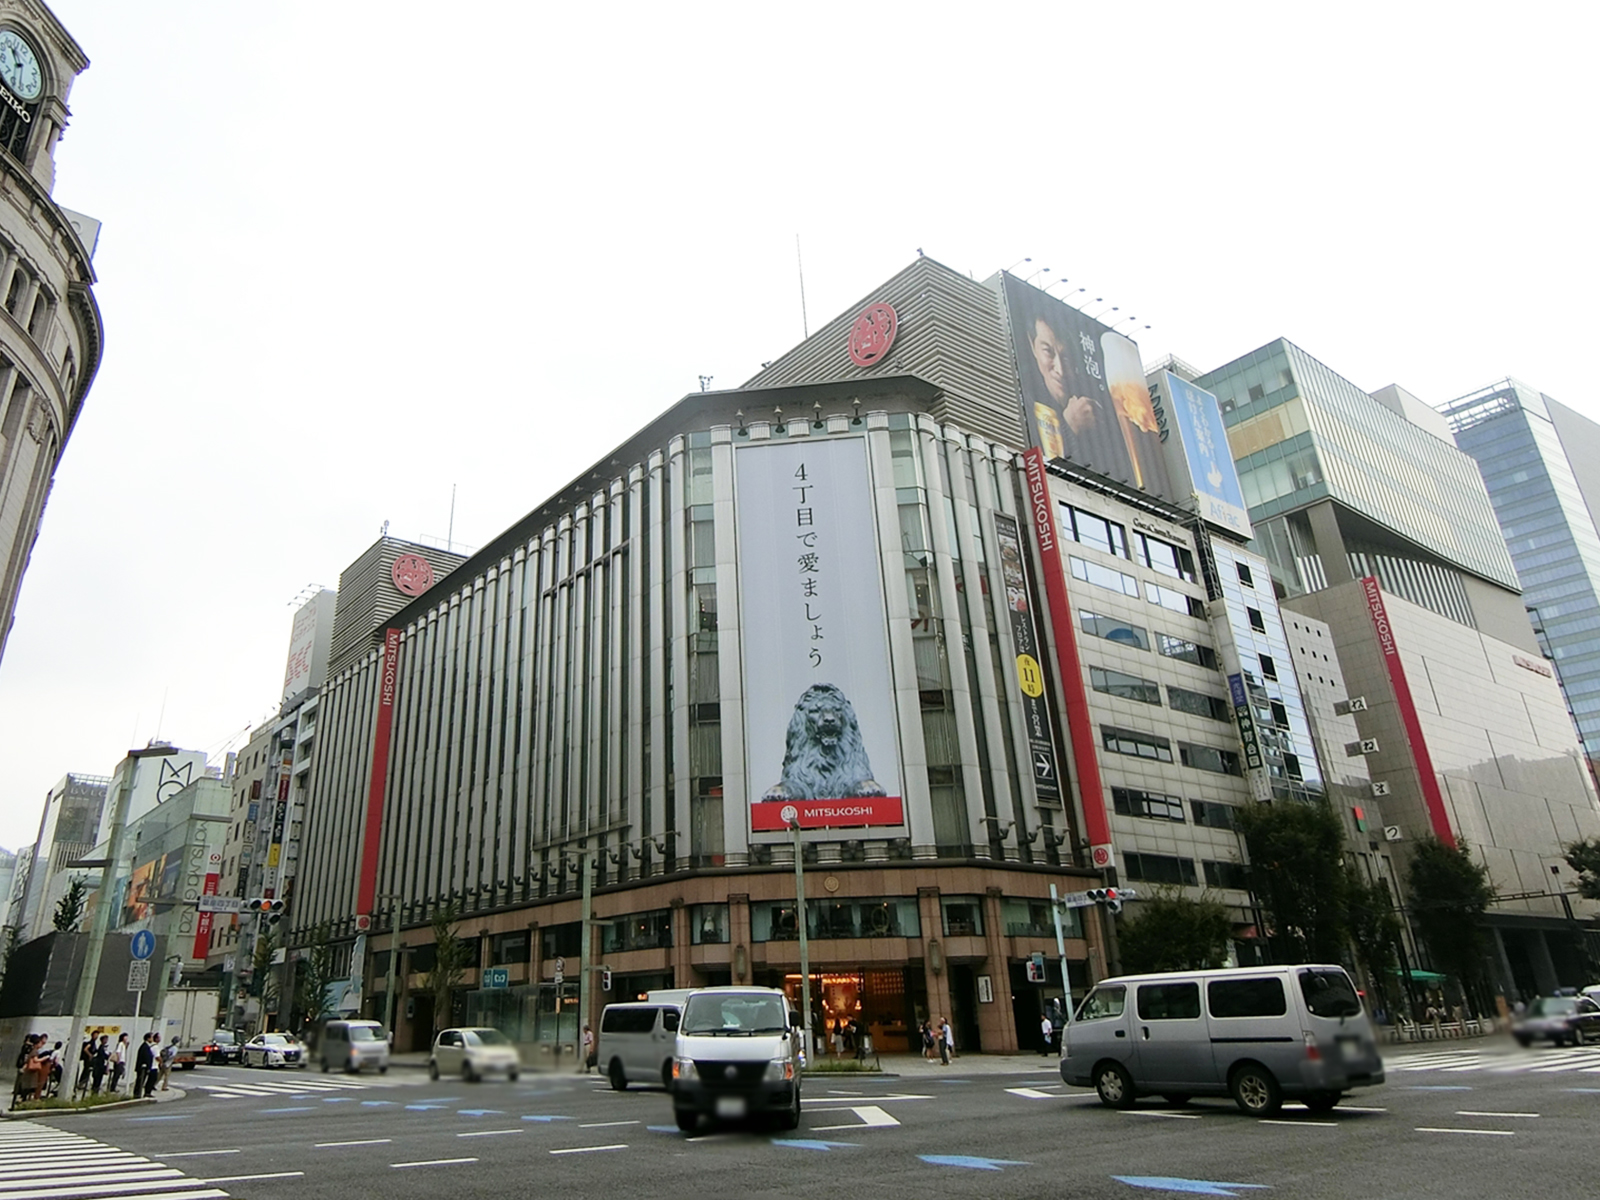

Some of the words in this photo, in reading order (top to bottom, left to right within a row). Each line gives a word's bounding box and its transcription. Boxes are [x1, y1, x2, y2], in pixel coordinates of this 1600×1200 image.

[1027, 453, 1053, 551] MITSUKOSHI
[792, 463, 825, 668] 4丁目で愛ましょう
[1365, 581, 1394, 656] MITSUKOSHI
[383, 633, 398, 705] MITSUKOSHI
[804, 806, 873, 818] MITSUKOSHI
